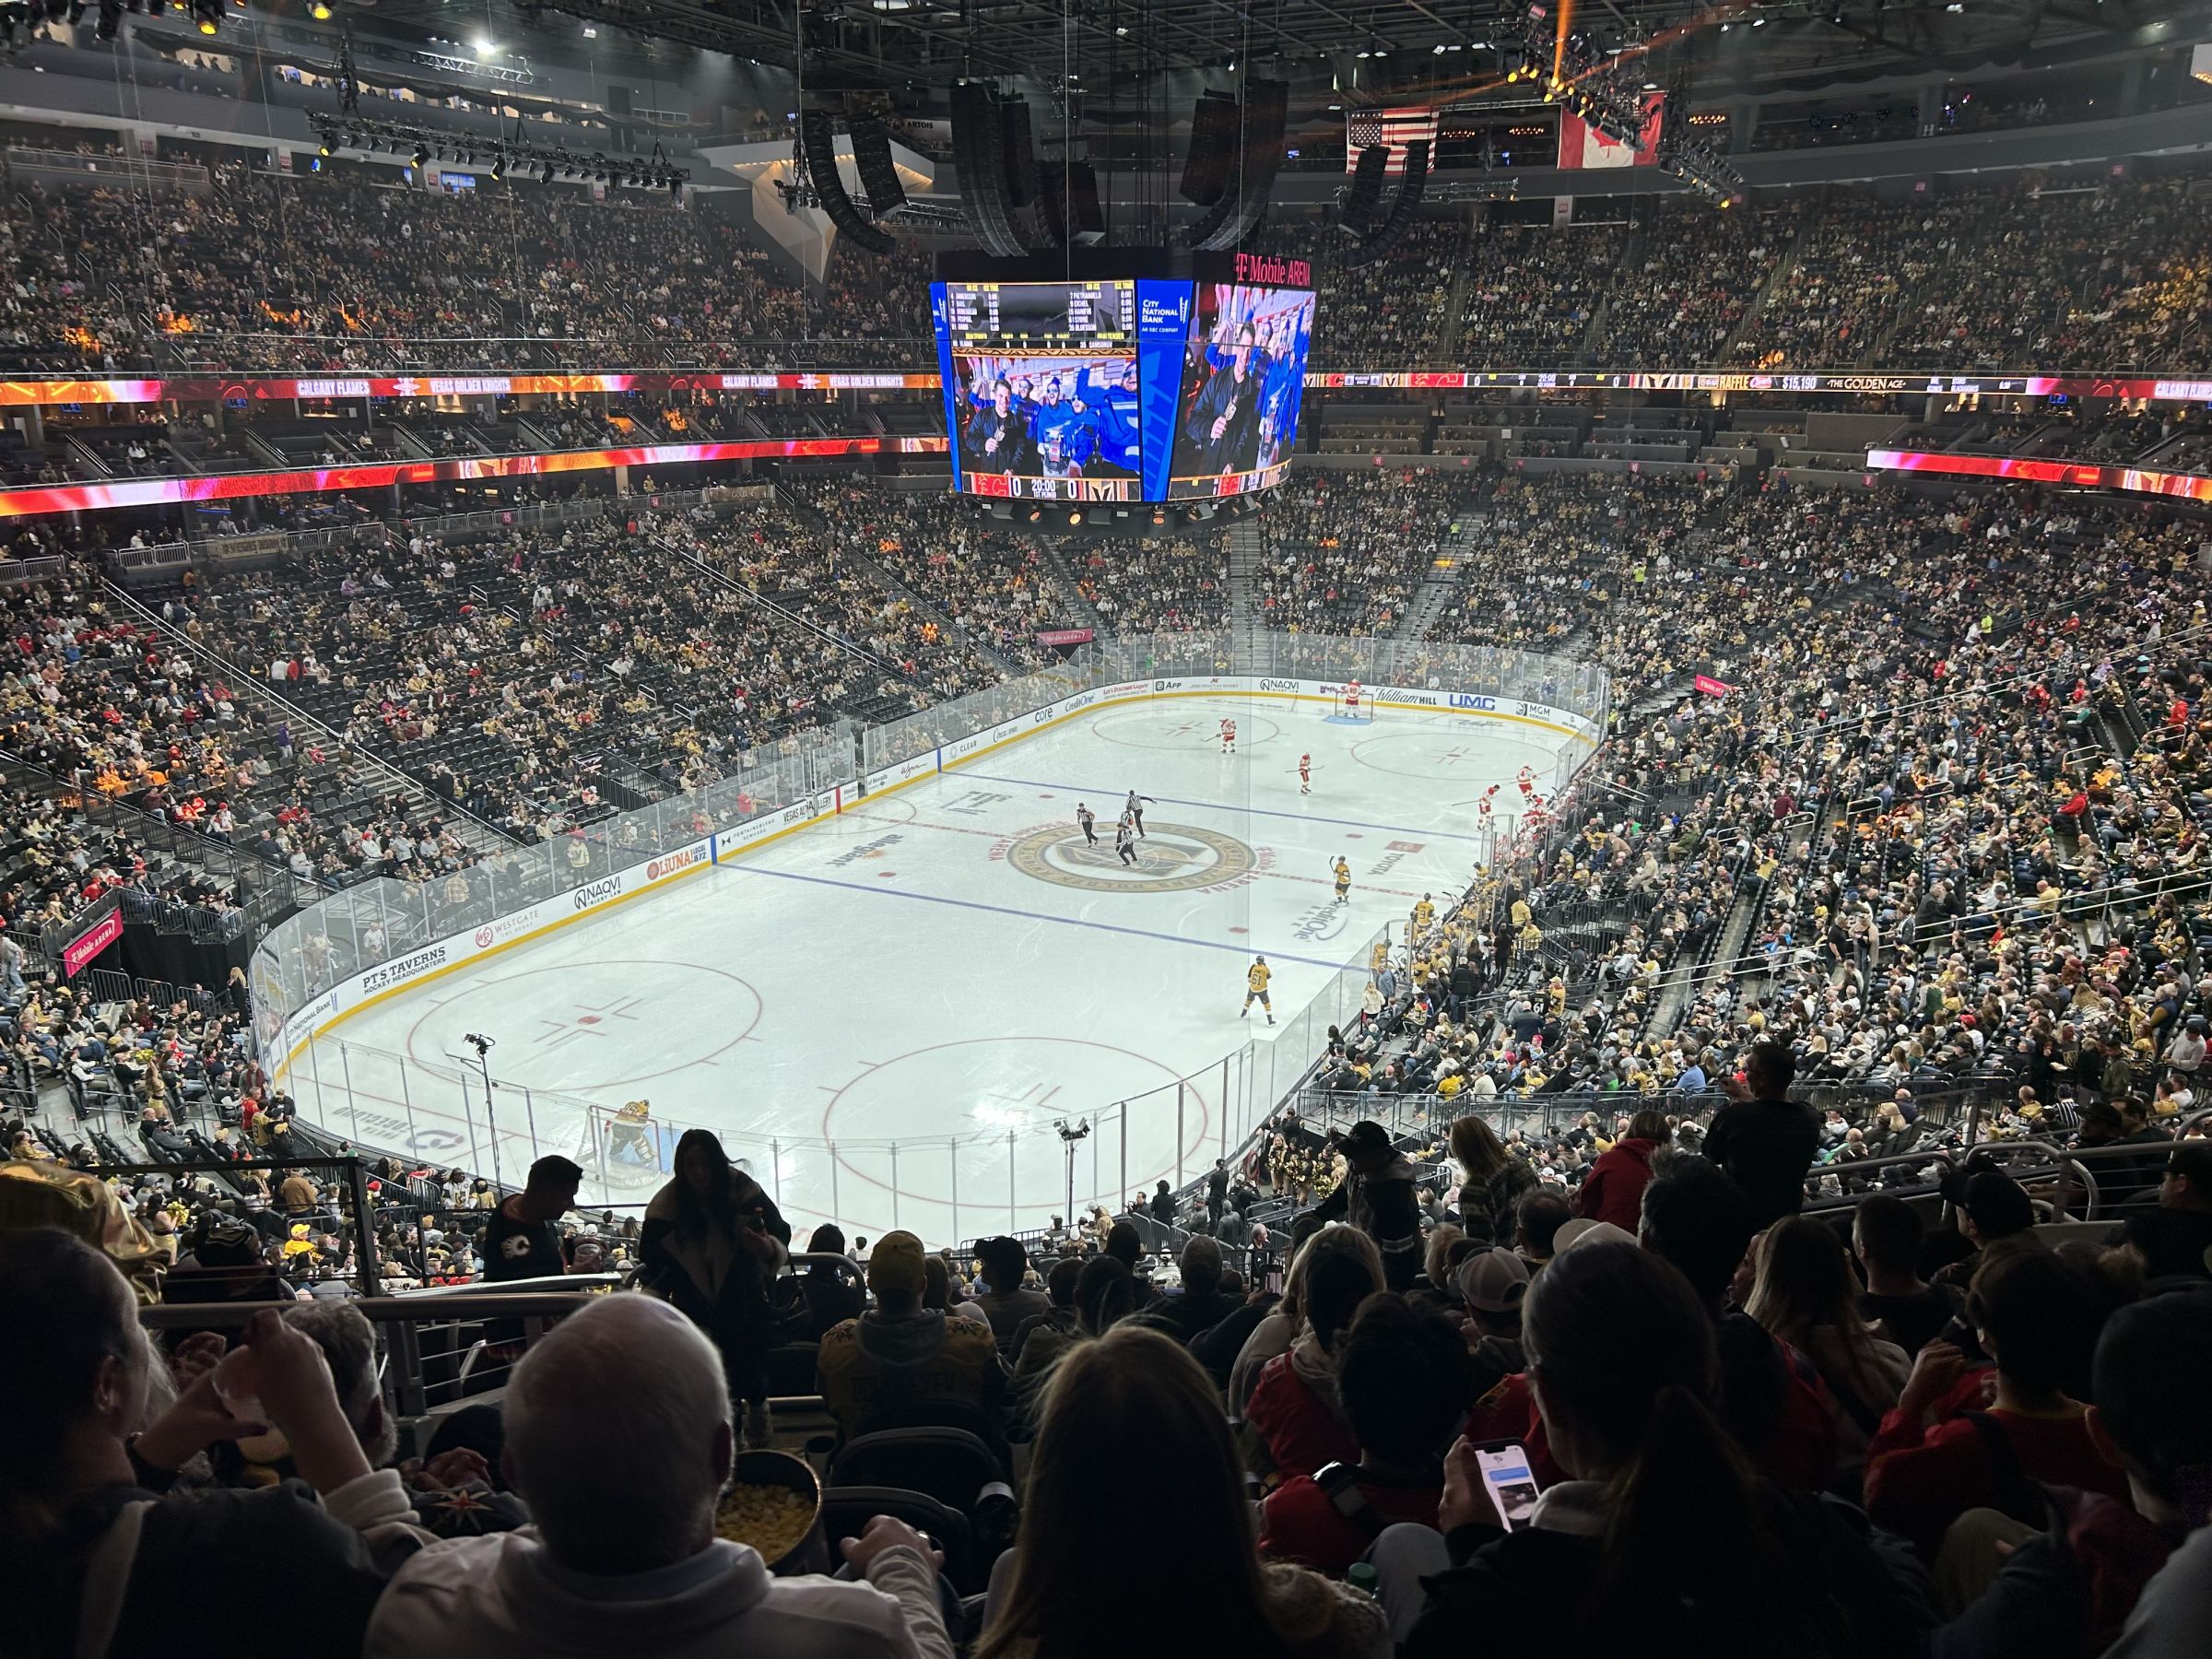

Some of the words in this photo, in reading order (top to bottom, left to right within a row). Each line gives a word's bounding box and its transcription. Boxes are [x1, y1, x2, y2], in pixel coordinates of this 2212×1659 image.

[1249, 256, 1286, 283] Mobile
[1287, 260, 1311, 287] ARENA
[1074, 291, 1101, 300] PIETRANGELO
[1142, 307, 1179, 316] NATIONAL
[1143, 300, 1159, 308] CITY
[1142, 314, 1163, 324] BANK
[297, 380, 335, 396] CALGARY
[336, 380, 370, 395] FLAMES
[430, 379, 453, 394] VEGAS
[454, 379, 481, 393] GOLDEN
[483, 378, 512, 393] KNIGHTS
[723, 376, 749, 387] CALGARY
[751, 376, 778, 387] FLAMES
[829, 375, 849, 387] VEGAS
[850, 375, 875, 386] GOLDEN
[876, 375, 904, 386] KNIGHTS
[1719, 376, 1749, 389] RAFFLE
[1782, 376, 1817, 391] $15,190
[1844, 378, 1888, 390] GOLDEN
[1887, 380, 1903, 389] AGE
[2155, 382, 2189, 398] CALGARY
[1014, 477, 1021, 497] 0
[1030, 478, 1056, 492] 20:00
[1067, 479, 1077, 499] 0
[1165, 681, 1182, 689] APP
[1270, 680, 1300, 690] NAQVI
[1065, 693, 1094, 712] CreditOne
[1375, 688, 1419, 704] William
[1419, 696, 1437, 706] HILL
[1449, 693, 1496, 712] UMC
[1529, 703, 1550, 716] MGM
[959, 739, 977, 753] CLEAR
[782, 808, 799, 823] VEGAS
[693, 844, 706, 855] LOCAL
[694, 851, 707, 863] 872
[658, 851, 694, 877] LiUNA!
[1367, 853, 1406, 876] TOYOTA
[587, 876, 621, 900] NAQVI
[1194, 874, 1260, 895] ARENA
[494, 909, 539, 934] WESTGATE
[1418, 910, 1427, 921] 9
[76, 941, 95, 959] Mobile
[95, 926, 113, 947] ARENA
[362, 969, 388, 989] PT'S
[388, 946, 446, 977] TAVERNS
[364, 978, 391, 995] HOCKEY
[392, 956, 447, 982] HEADQUARTERS
[1252, 973, 1261, 986] 61
[293, 1012, 317, 1030] NATIONAL
[315, 1000, 331, 1015] BANK
[1534, 1003, 1545, 1015] 61
